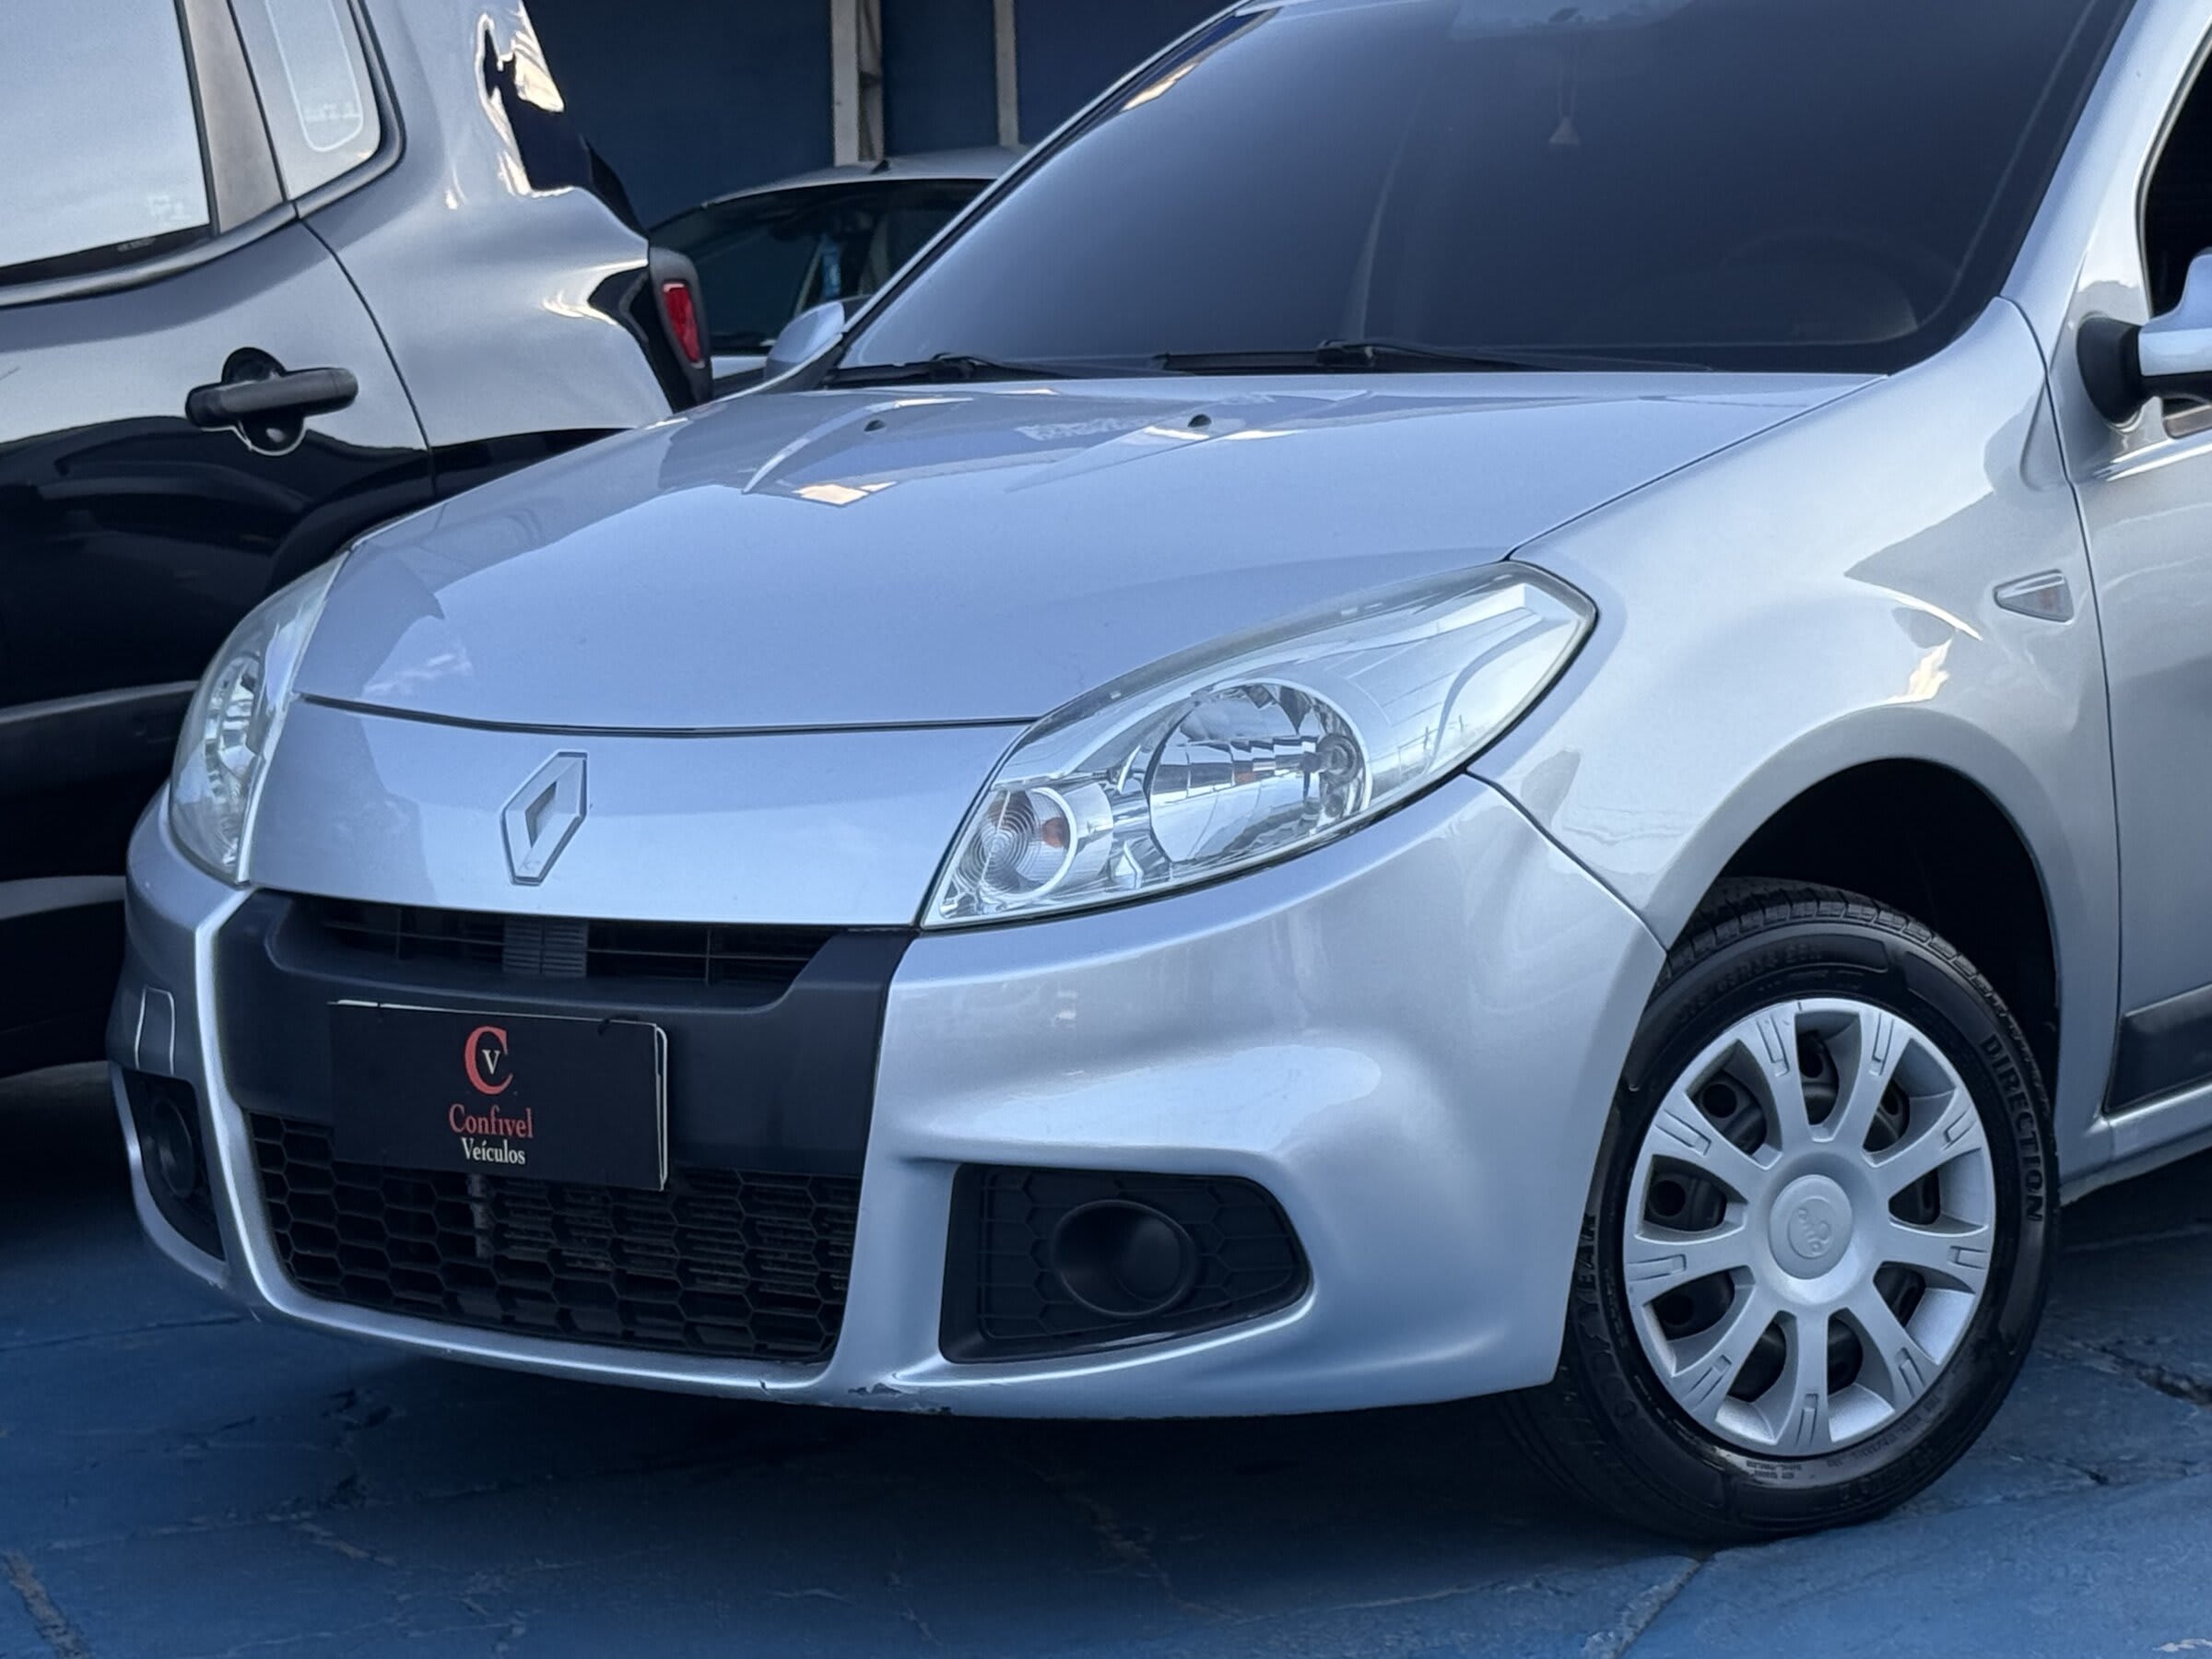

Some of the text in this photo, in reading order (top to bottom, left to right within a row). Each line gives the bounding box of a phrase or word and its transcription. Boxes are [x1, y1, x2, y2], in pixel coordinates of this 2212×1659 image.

[450, 1103, 533, 1137] Confivel
[1982, 1033, 2043, 1222] DIRECTION
[462, 1138, 525, 1165] Veículos
